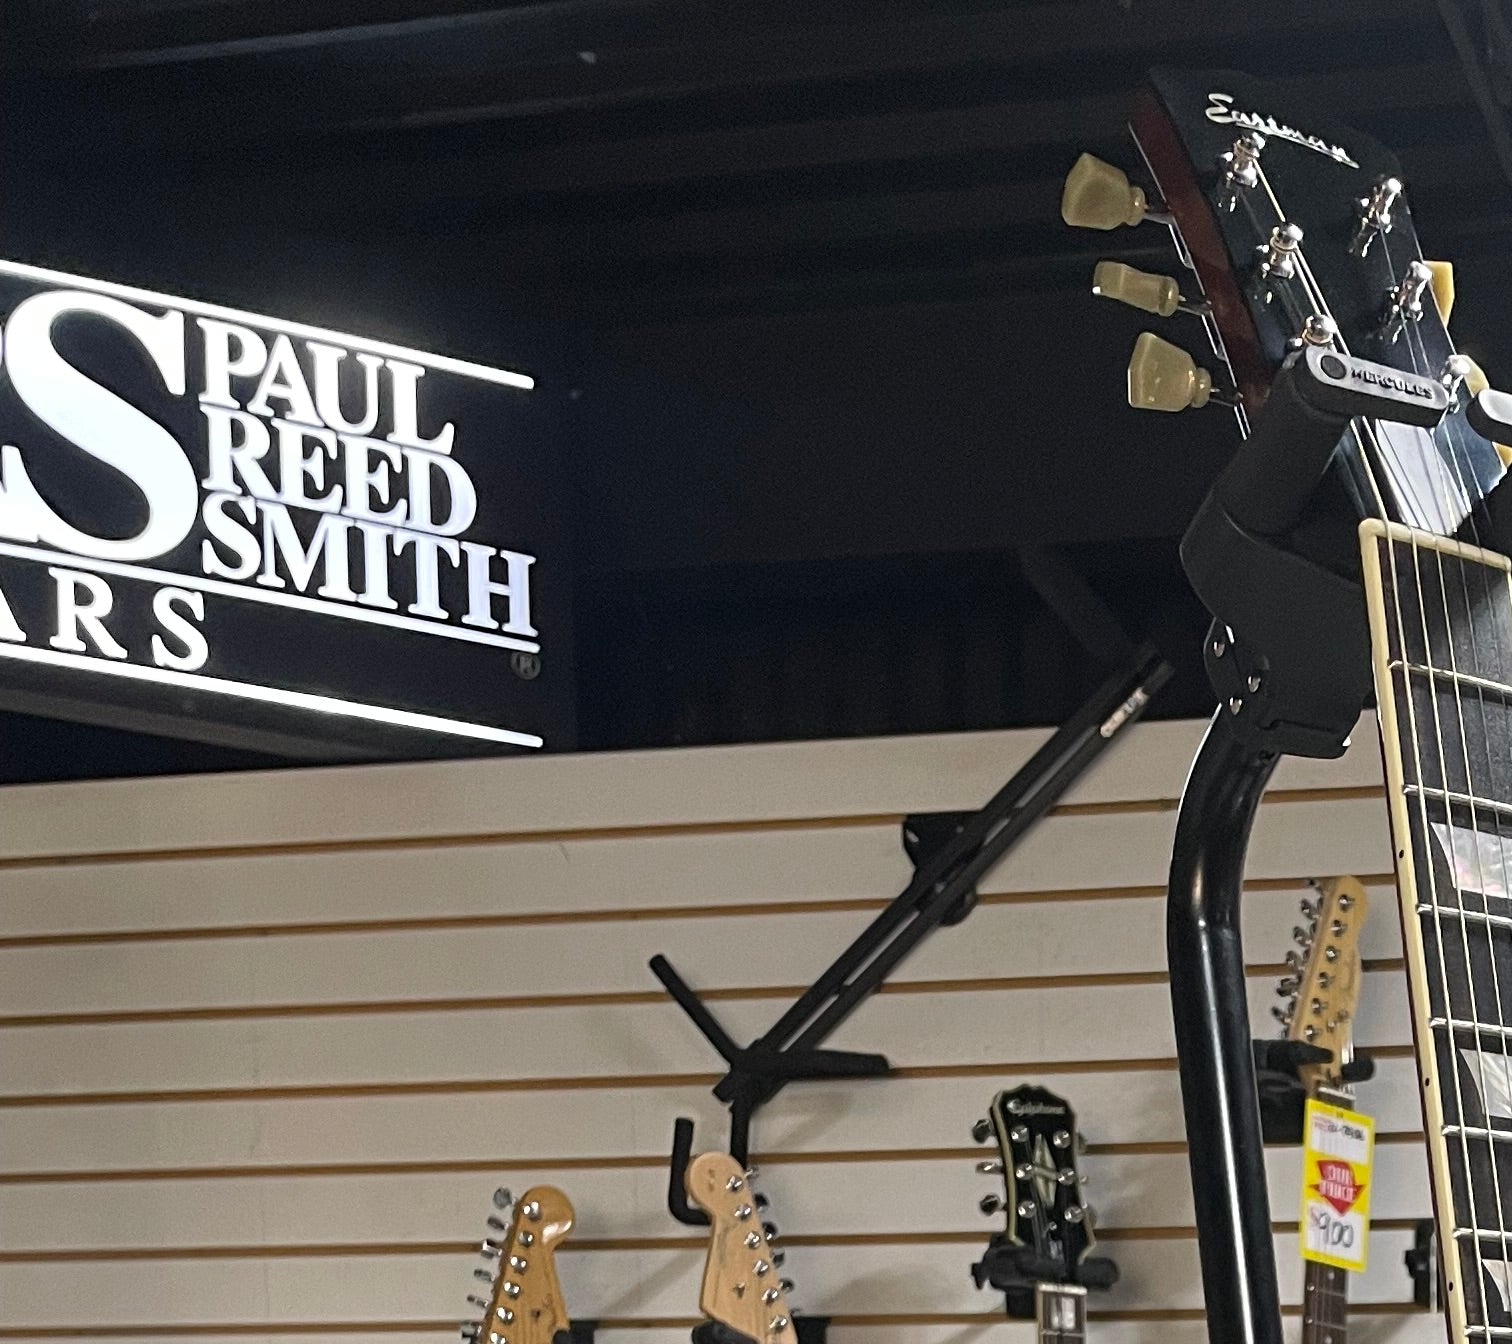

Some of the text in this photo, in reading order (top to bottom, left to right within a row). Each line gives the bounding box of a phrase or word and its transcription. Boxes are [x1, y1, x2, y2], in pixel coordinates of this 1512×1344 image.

[196, 317, 455, 455] PAUL
[1350, 366, 1433, 400] HERCULES
[200, 405, 478, 538] REED
[201, 490, 539, 638] SMITH
